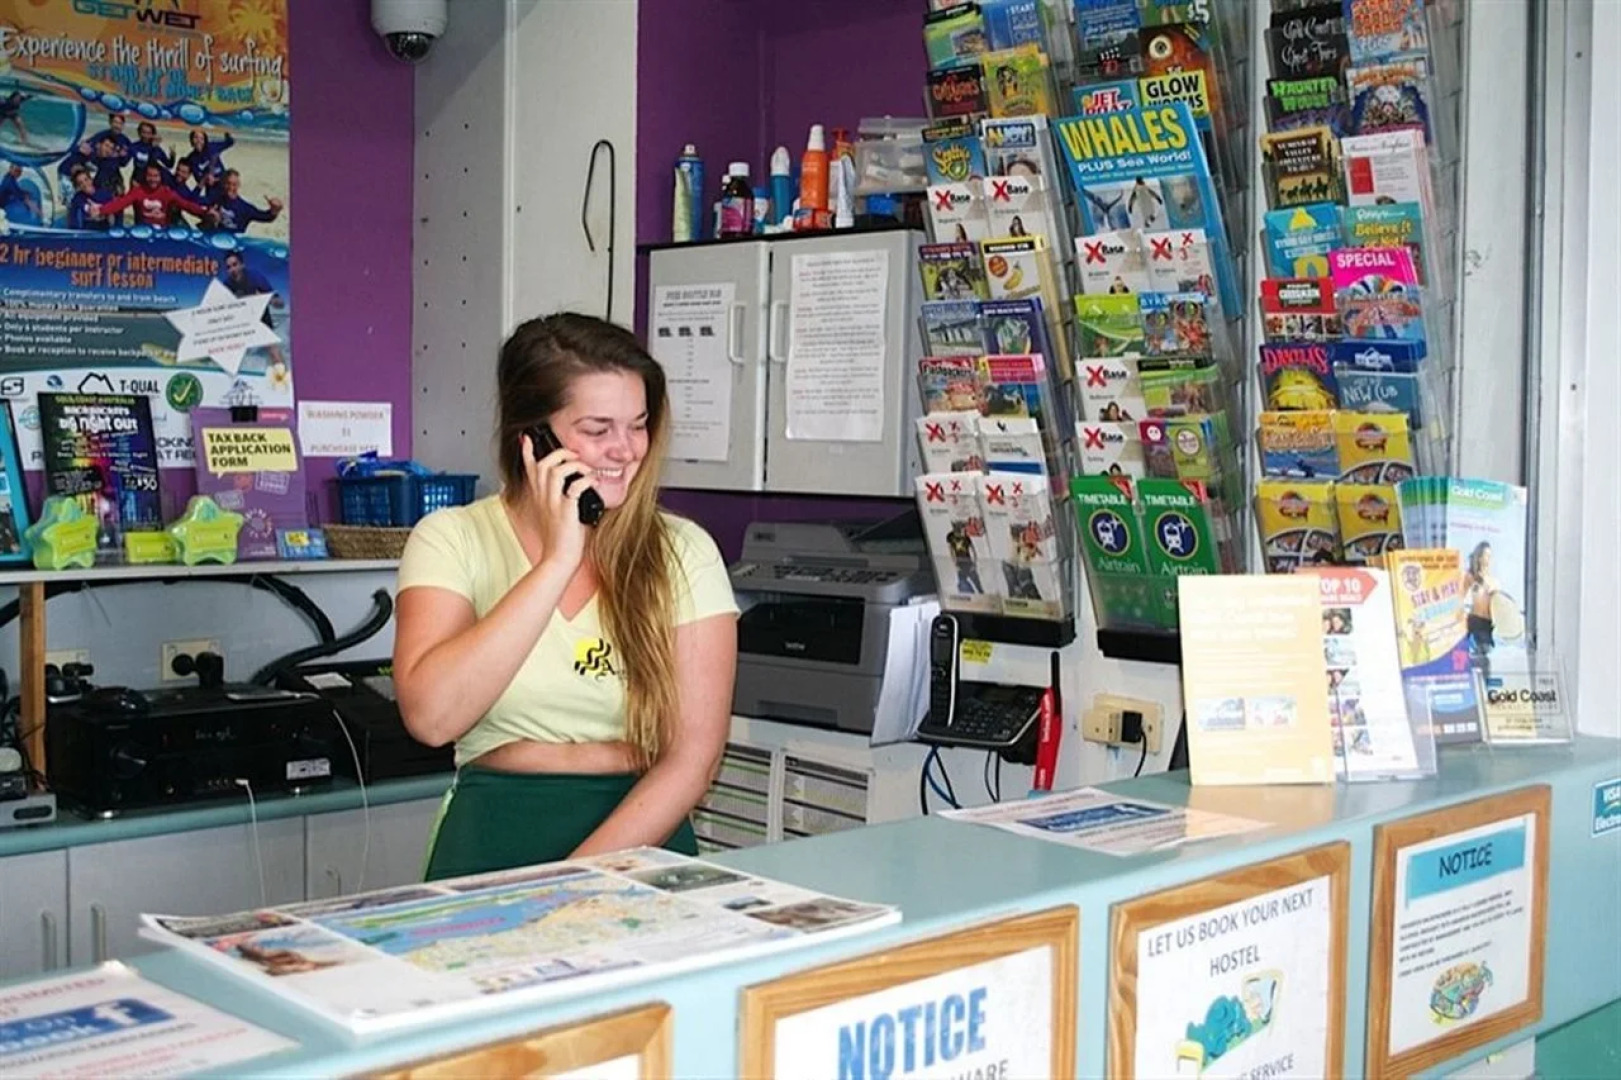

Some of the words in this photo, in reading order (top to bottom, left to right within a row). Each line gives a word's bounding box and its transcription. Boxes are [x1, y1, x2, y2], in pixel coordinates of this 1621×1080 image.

[0, 27, 106, 68] Experience
[113, 34, 141, 65] the
[149, 36, 190, 73] thrill
[195, 34, 215, 84] of
[220, 40, 284, 87] surfing
[1146, 75, 1199, 99] GLOW
[1060, 107, 1188, 161] WHALES
[1078, 161, 1114, 173] PLUS
[1117, 157, 1145, 168] Sea
[1146, 151, 1191, 165] World!
[0, 243, 10, 262] 2
[14, 245, 32, 264] hr
[35, 247, 102, 269] beginner
[106, 252, 122, 270] or
[127, 252, 219, 275] intermediate
[1336, 252, 1396, 268] SPECIAL
[70, 268, 103, 287] surf
[107, 269, 154, 288] lesson
[120, 379, 161, 394] T-QUAL
[208, 432, 235, 443] TAX
[236, 432, 267, 443] BACK
[210, 443, 292, 455] APPLICATION
[212, 456, 248, 468] FORM
[1078, 493, 1127, 505] TIMETABLE
[1144, 494, 1196, 506] TIMETABLE
[1098, 557, 1141, 573] Airtrain
[1161, 562, 1209, 576] Airtrain
[1320, 577, 1342, 594] OP
[1344, 577, 1361, 594] 10
[1488, 689, 1518, 705] Gold
[1520, 689, 1556, 702] Coast
[1438, 842, 1493, 879] NOTICE
[1148, 932, 1173, 957] LET
[1176, 925, 1196, 949] US
[1198, 912, 1239, 942] BOOK
[1242, 900, 1281, 928] YOUR
[1281, 888, 1315, 914] NEXT
[1209, 944, 1260, 978] HOSTEL
[837, 986, 988, 1080] NOTICE
[1249, 1053, 1294, 1080] SERVICE
